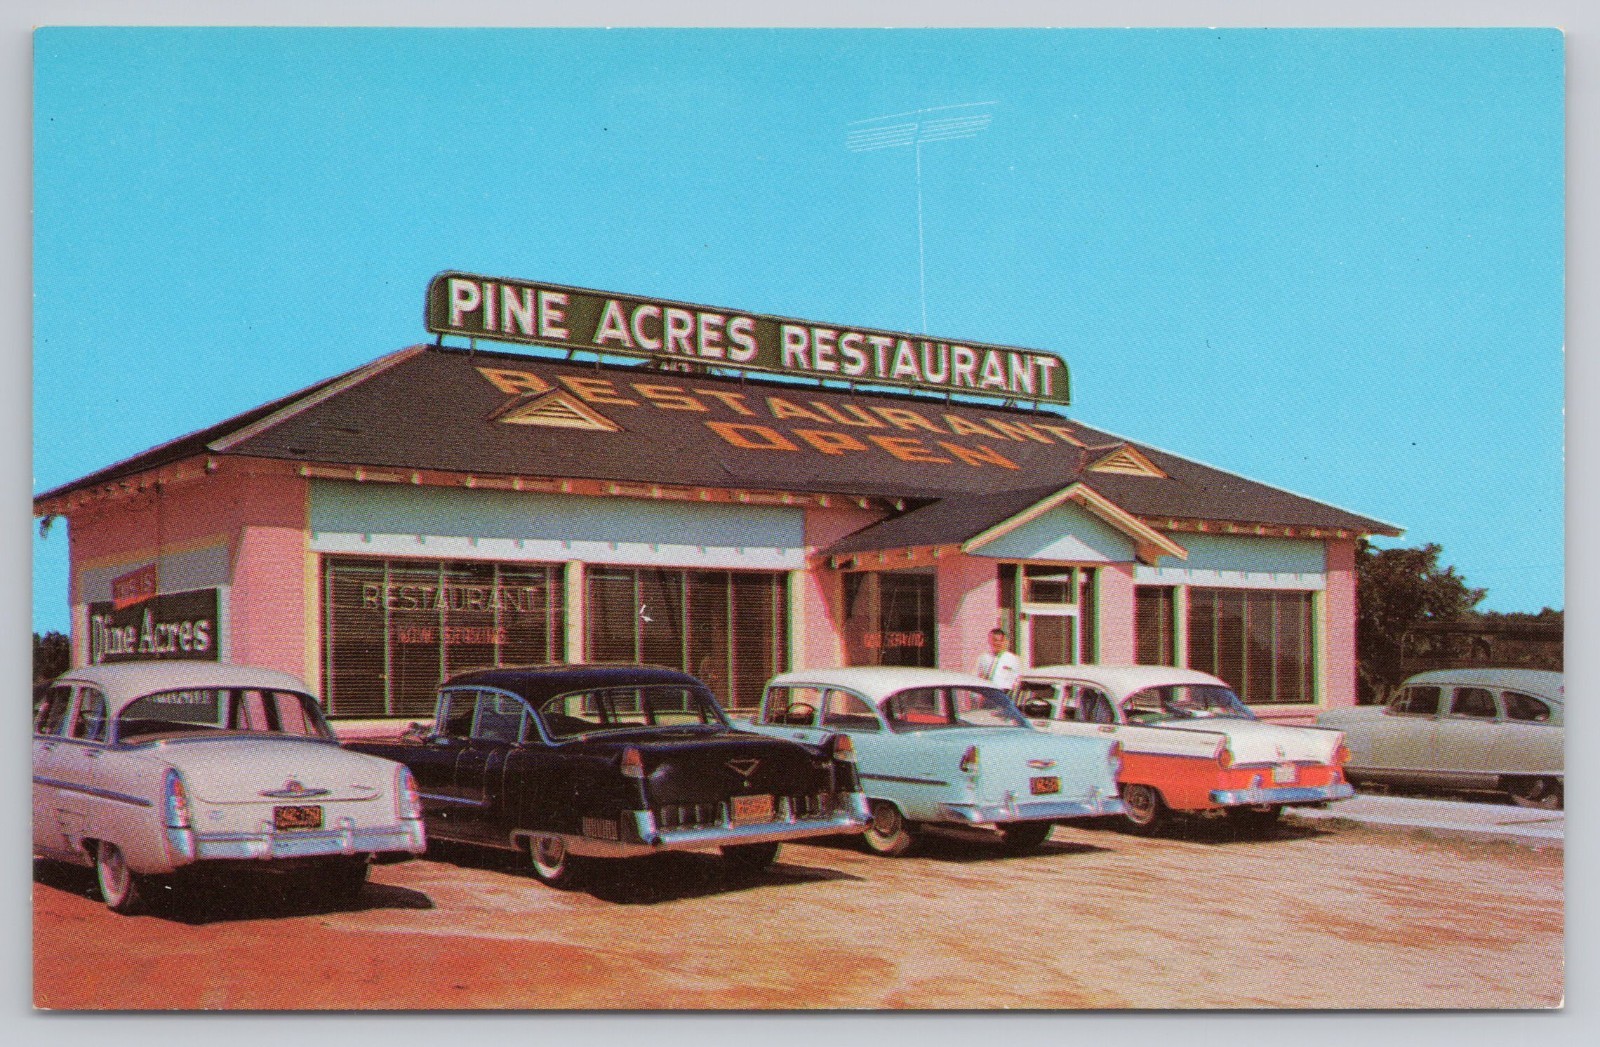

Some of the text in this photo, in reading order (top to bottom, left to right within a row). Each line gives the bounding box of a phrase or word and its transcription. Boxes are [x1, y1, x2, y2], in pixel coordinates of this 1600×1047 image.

[448, 278, 1060, 396] PINE ACRES RESTAURANT
[474, 366, 1089, 448] RESTAURANT
[703, 421, 1022, 471] OPEN
[362, 583, 539, 612] RESTAURANT
[139, 607, 211, 653] Acres
